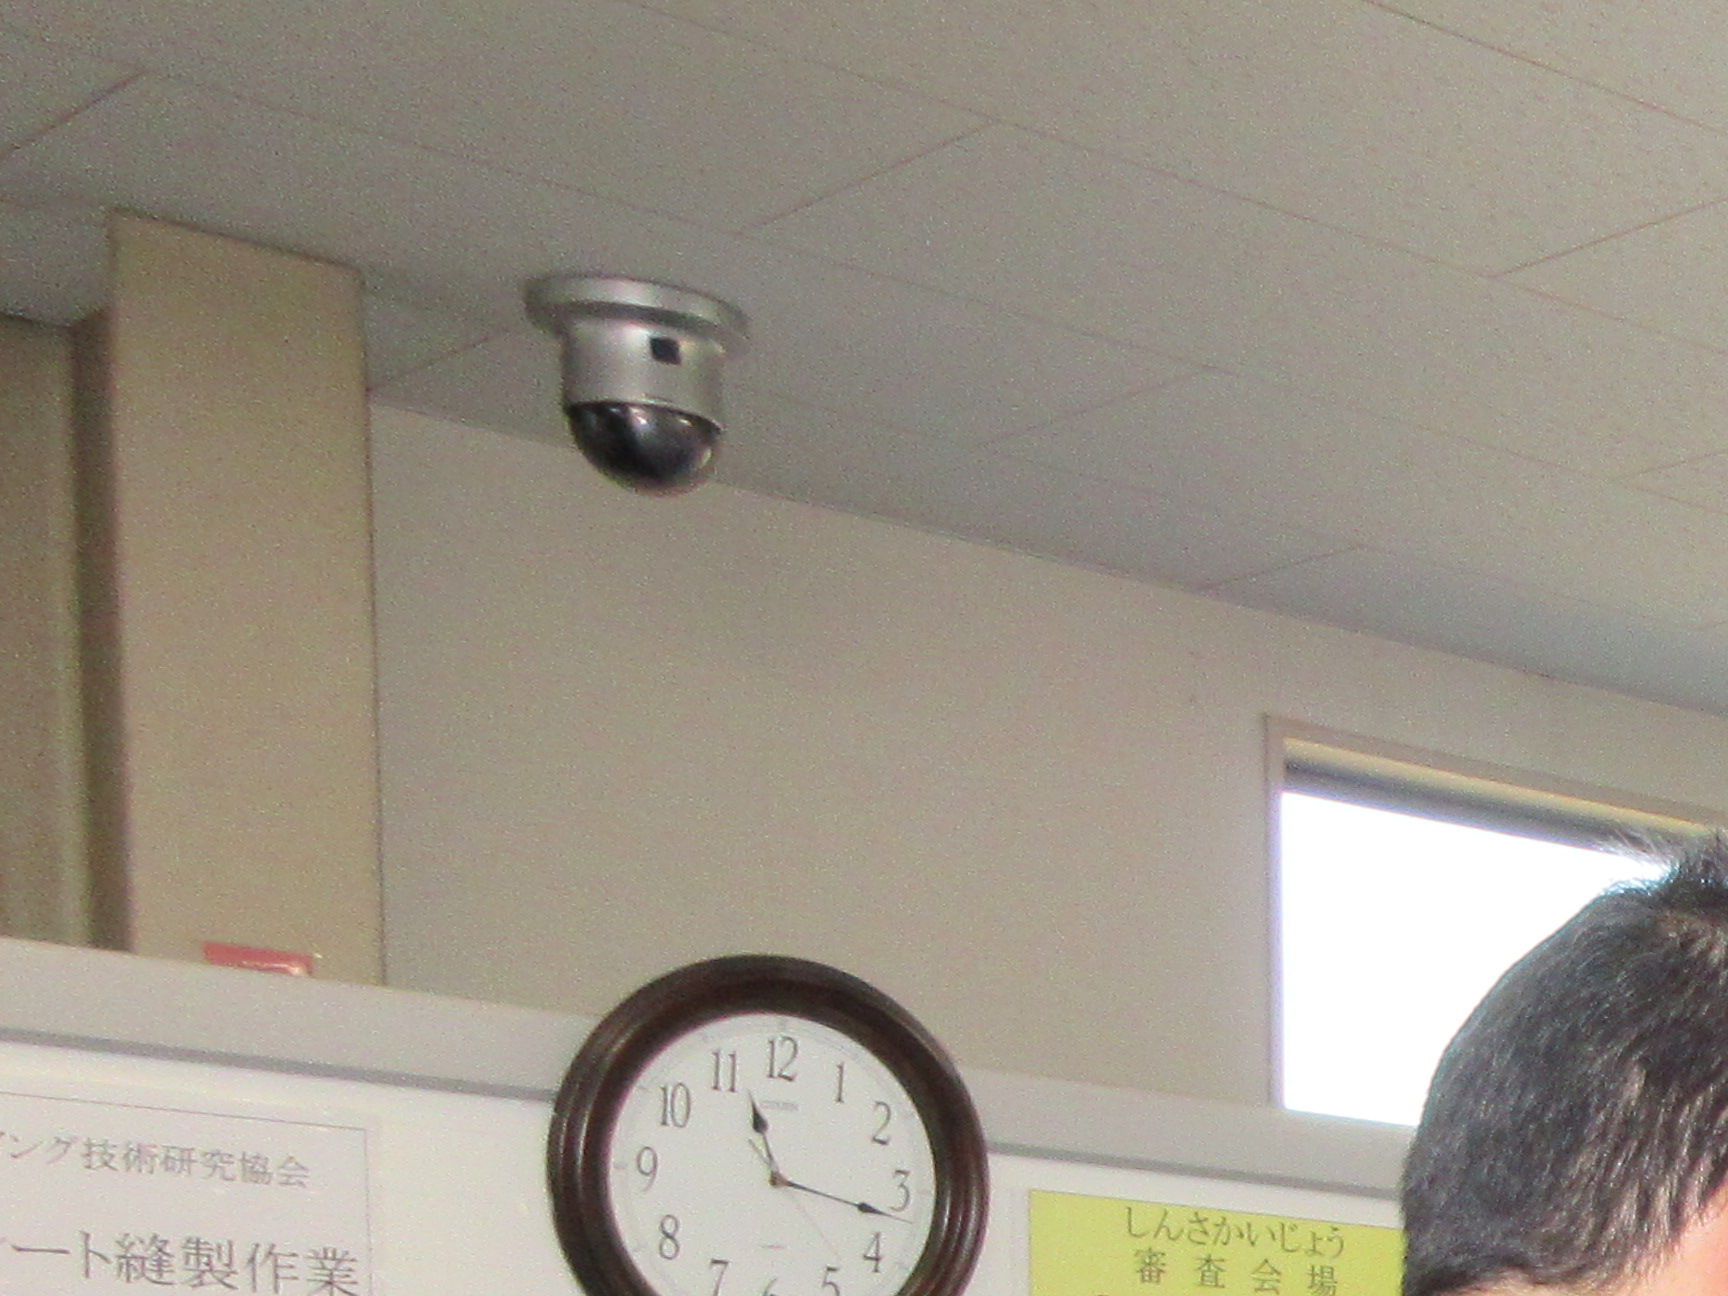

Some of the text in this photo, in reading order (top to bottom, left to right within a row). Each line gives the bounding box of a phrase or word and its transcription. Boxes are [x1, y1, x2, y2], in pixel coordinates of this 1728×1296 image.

[711, 1049, 738, 1093] 11
[767, 1036, 798, 1082] 12
[835, 1061, 846, 1103] 1
[660, 1082, 691, 1127] 10
[871, 1102, 892, 1145] 2
[0, 1131, 311, 1189] ング技術研究協会
[636, 1146, 658, 1191] 9
[889, 1169, 911, 1212] 3
[658, 1215, 681, 1259] 8
[863, 1232, 883, 1274] 4
[1125, 1205, 1346, 1259] しんさかいじょう
